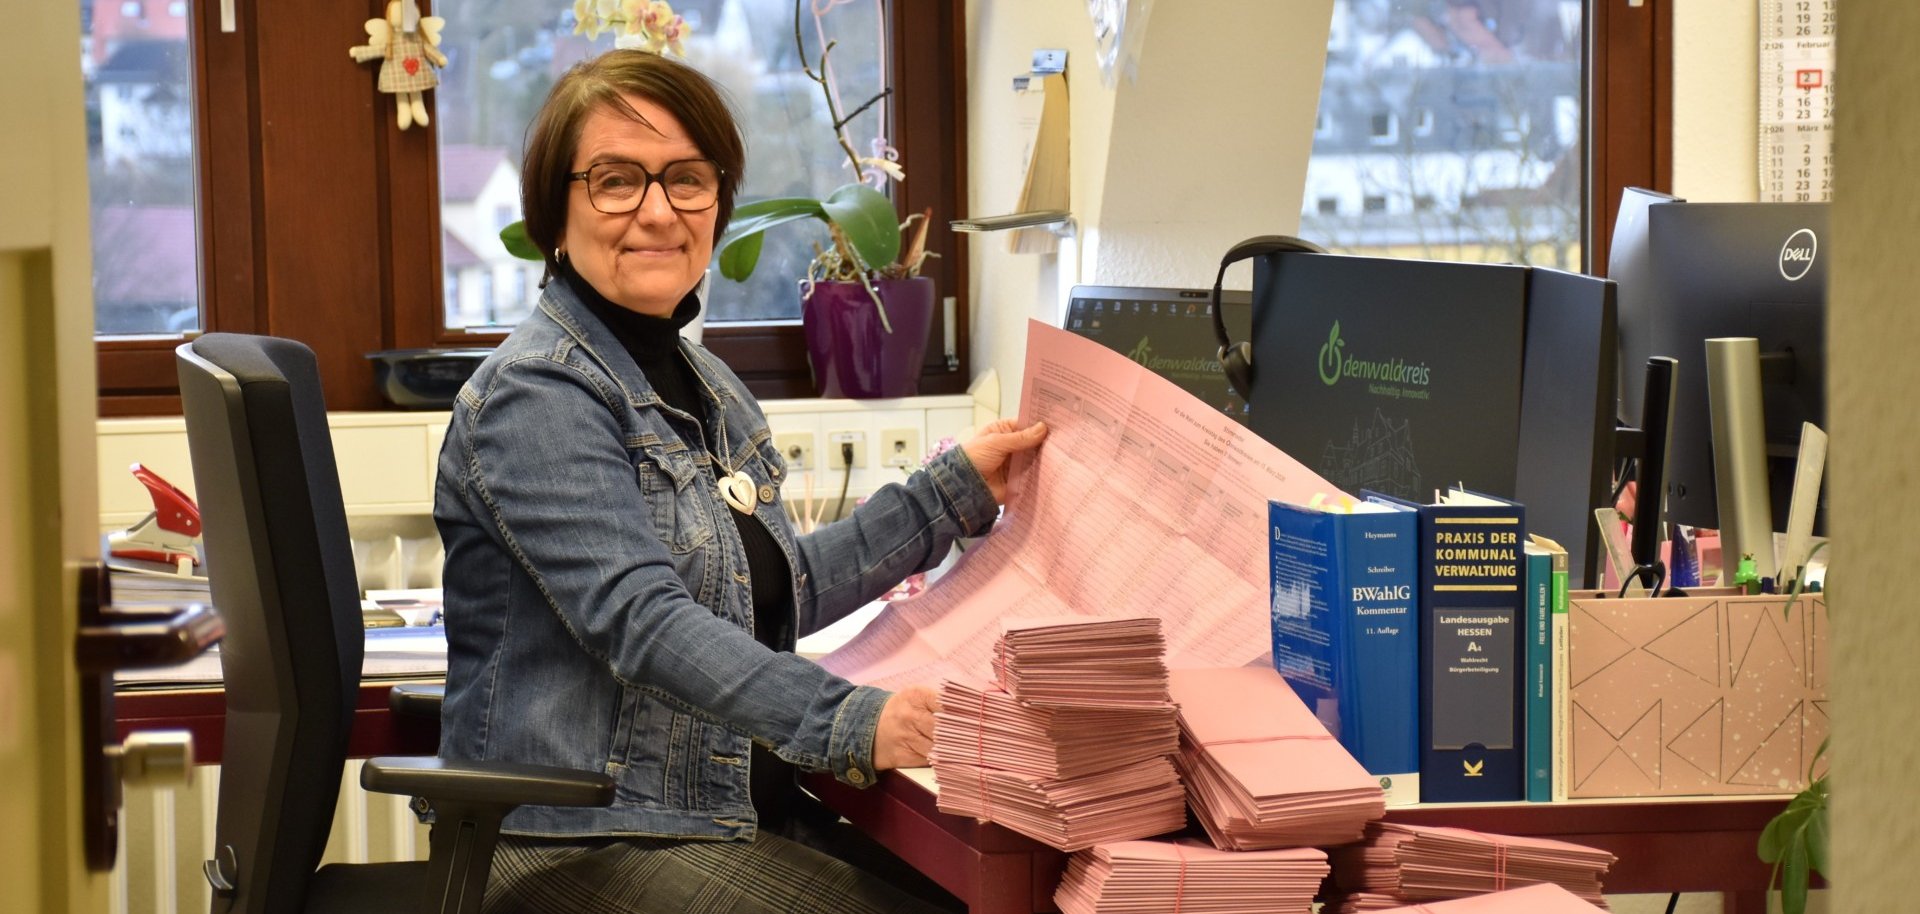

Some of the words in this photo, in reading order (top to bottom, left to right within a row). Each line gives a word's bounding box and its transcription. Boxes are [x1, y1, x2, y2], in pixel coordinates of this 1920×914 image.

[1796, 2, 1810, 11] 12
[1796, 14, 1811, 23] 19
[1796, 26, 1811, 36] 26
[1804, 73, 1810, 82] 2
[1797, 98, 1811, 107] 16
[1797, 110, 1811, 119] 23
[1772, 145, 1784, 155] 10
[1803, 144, 1810, 154] 2
[1772, 157, 1783, 167] 11
[1803, 156, 1810, 166] 9
[1772, 170, 1784, 179] 12
[1797, 169, 1811, 178] 16
[1772, 182, 1784, 191] 13
[1796, 181, 1810, 191] 23
[1796, 193, 1810, 202] 30
[1784, 247, 1811, 261] DELL
[1365, 532, 1397, 540] Heymanns
[1436, 532, 1485, 544] PRAXIS
[1490, 532, 1517, 544] DER
[1436, 549, 1516, 560] KOMMUNAL
[1435, 565, 1517, 577] VERWALTUNG
[1352, 585, 1411, 602] BWahlG
[1357, 606, 1408, 615] Kommentar
[1440, 616, 1510, 625] Landesausgabe
[1377, 627, 1399, 635] Auflage
[1457, 628, 1493, 637] HESSEN
